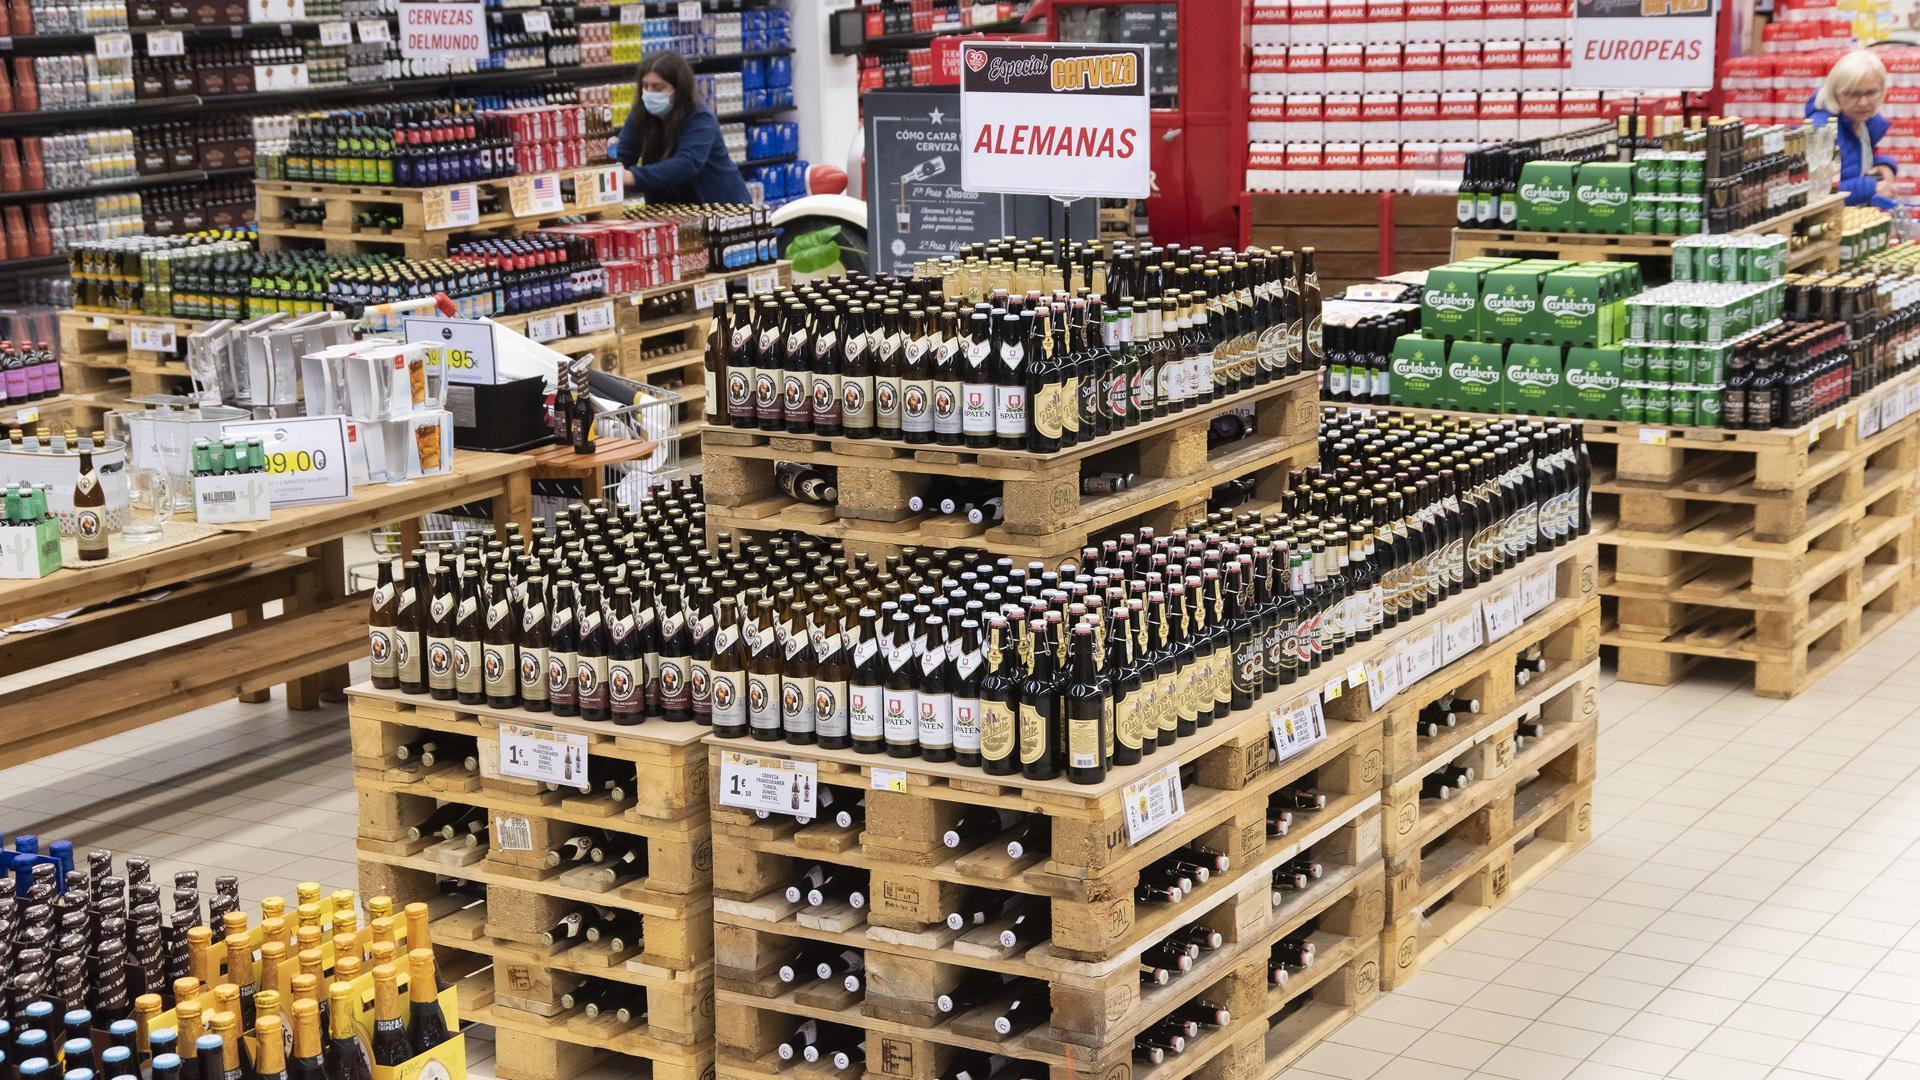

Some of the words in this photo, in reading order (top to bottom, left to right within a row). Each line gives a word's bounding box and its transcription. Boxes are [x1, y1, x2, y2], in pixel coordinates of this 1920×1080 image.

[1370, 8, 1402, 16] AMBAR
[1409, 6, 1442, 14] AMBAR
[1449, 5, 1481, 14] AMBAR
[1487, 4, 1522, 14] AMBAR
[1528, 3, 1562, 12] AMBAR
[408, 9, 473, 25] CERVEZAS
[1256, 10, 1287, 18] AMBAR
[1294, 10, 1324, 18] AMBAR
[1331, 8, 1364, 18] AMBAR
[408, 34, 479, 50] DELMUNDO
[1584, 39, 1702, 61] EUROPEAS
[1253, 58, 1284, 67] AMBAR
[1290, 58, 1322, 67] AMBAR
[1328, 58, 1360, 66] AMBAR
[1366, 57, 1398, 66] AMBAR
[1406, 56, 1438, 65] AMBAR
[1446, 55, 1478, 64] AMBAR
[1485, 54, 1518, 64] AMBAR
[1524, 54, 1559, 62] AMBAR
[988, 54, 1048, 84] Especial
[1250, 108, 1282, 116] AMBAR
[1288, 107, 1319, 116] AMBAR
[1326, 107, 1358, 116] AMBAR
[1364, 106, 1396, 115] AMBAR
[1404, 106, 1436, 114] AMBAR
[1443, 105, 1475, 114] AMBAR
[1482, 104, 1514, 113] AMBAR
[1522, 104, 1556, 112] AMBAR
[895, 129, 925, 141] CÓMO
[926, 131, 957, 141] CATAR
[973, 124, 1137, 159] ALEMANAS
[916, 142, 960, 152] CERVEZA
[1251, 156, 1282, 164] AMBAR
[1288, 156, 1319, 164] AMBAR
[1326, 155, 1358, 164] AMBAR
[1364, 154, 1396, 164] AMBAR
[1404, 155, 1436, 164] AMBAR
[1520, 184, 1570, 204] Carlsberg
[1577, 185, 1628, 206] Carlsberg
[1425, 290, 1475, 311] Carlsberg
[1484, 293, 1536, 314] Carlsberg
[1542, 296, 1596, 317] Carlsberg
[1393, 358, 1442, 380] Carlsberg
[1449, 362, 1500, 384] Carlsberg
[1507, 364, 1560, 387] Carlsberg
[1566, 368, 1620, 391] Carlsberg
[963, 410, 991, 418] SPATEN
[202, 490, 236, 503] MALQUERIDA
[509, 744, 520, 764] 1
[532, 748, 559, 757] FRANZISKANER
[1363, 754, 1379, 778] EPAL
[762, 772, 780, 780] CERVEZA
[730, 774, 741, 795] 1
[756, 778, 785, 786] FRANZISKANER
[1400, 806, 1415, 830] EPAL
[1358, 967, 1373, 990] EPAL
